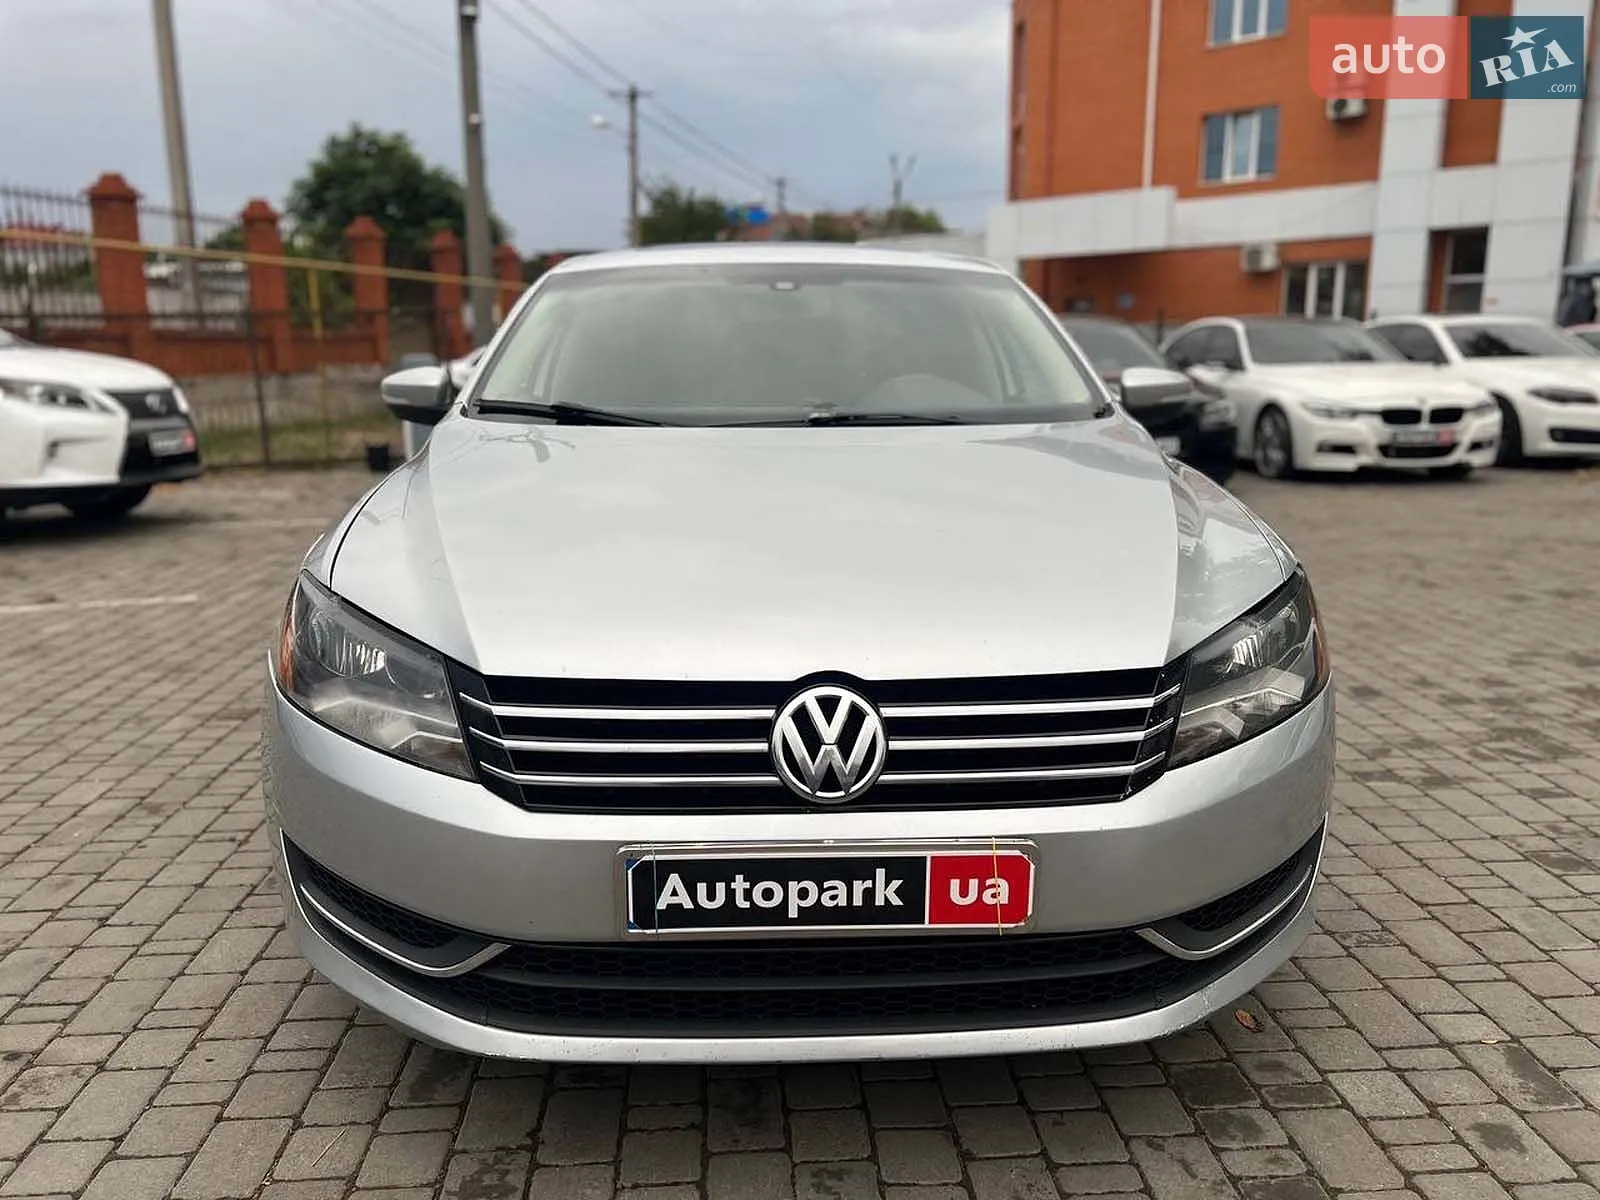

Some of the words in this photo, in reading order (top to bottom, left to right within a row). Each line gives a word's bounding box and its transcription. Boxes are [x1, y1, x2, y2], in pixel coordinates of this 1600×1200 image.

[774, 687, 884, 800] VW
[655, 868, 904, 918] Autopark
[949, 877, 1010, 905] ua
